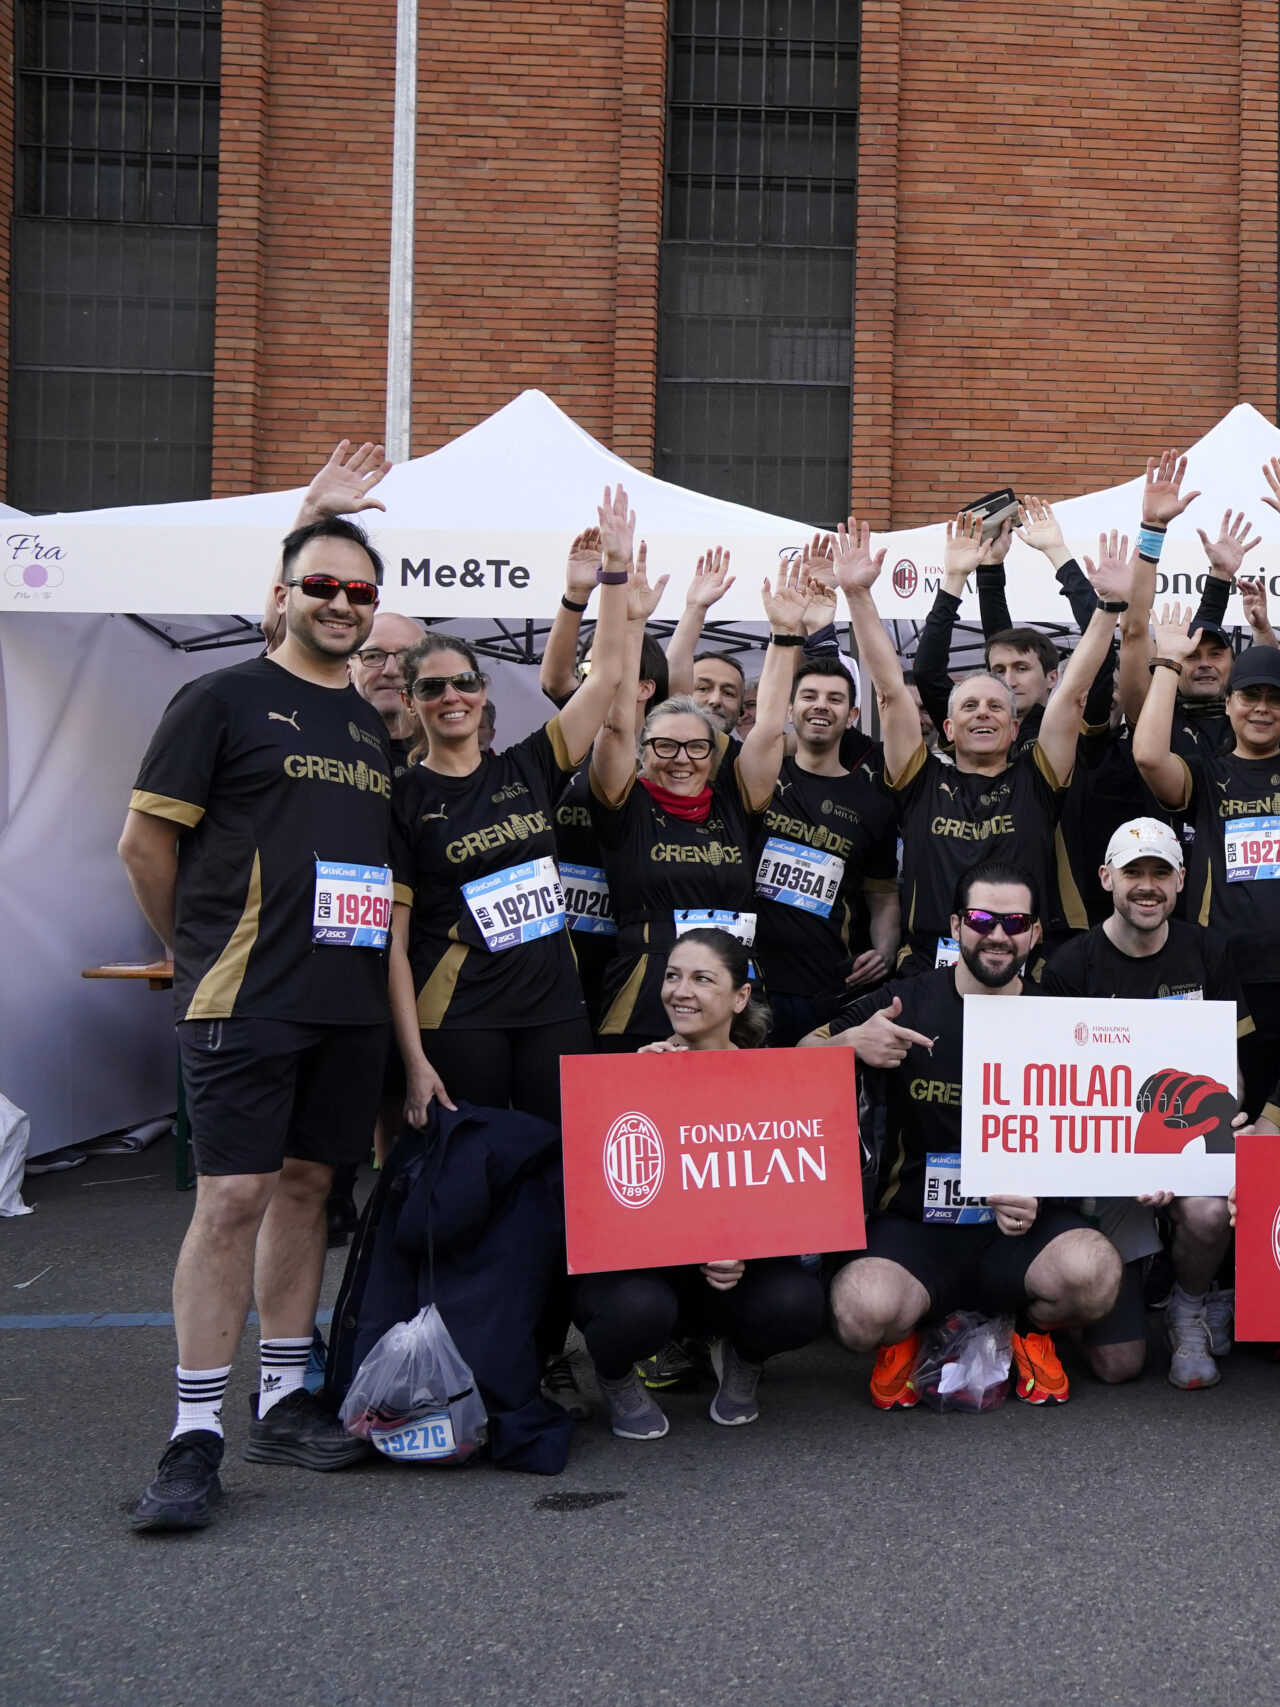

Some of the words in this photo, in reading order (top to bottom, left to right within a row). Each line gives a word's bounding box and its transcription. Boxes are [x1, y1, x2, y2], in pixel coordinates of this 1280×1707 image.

[6, 534, 68, 560] Fra
[401, 558, 531, 588] Me&Te
[833, 808, 860, 825] MILAN
[328, 867, 357, 877] UniCredit
[770, 861, 826, 899] 1935A
[336, 893, 390, 929] 1926D
[493, 886, 556, 928] 1927C
[326, 930, 347, 938] asics
[498, 933, 516, 944] asics
[1092, 1033, 1131, 1044] MILAN
[982, 1063, 1011, 1106] IL
[1023, 1063, 1132, 1107] MILAN
[616, 1119, 651, 1138] ACM
[679, 1119, 824, 1145] FONDAZIONE
[982, 1114, 1039, 1153] PER
[1050, 1115, 1132, 1154] TUTTI
[680, 1145, 827, 1190] MILAN
[621, 1184, 650, 1197] 1899
[934, 1210, 953, 1218] asics
[378, 1424, 447, 1453] 1927C
